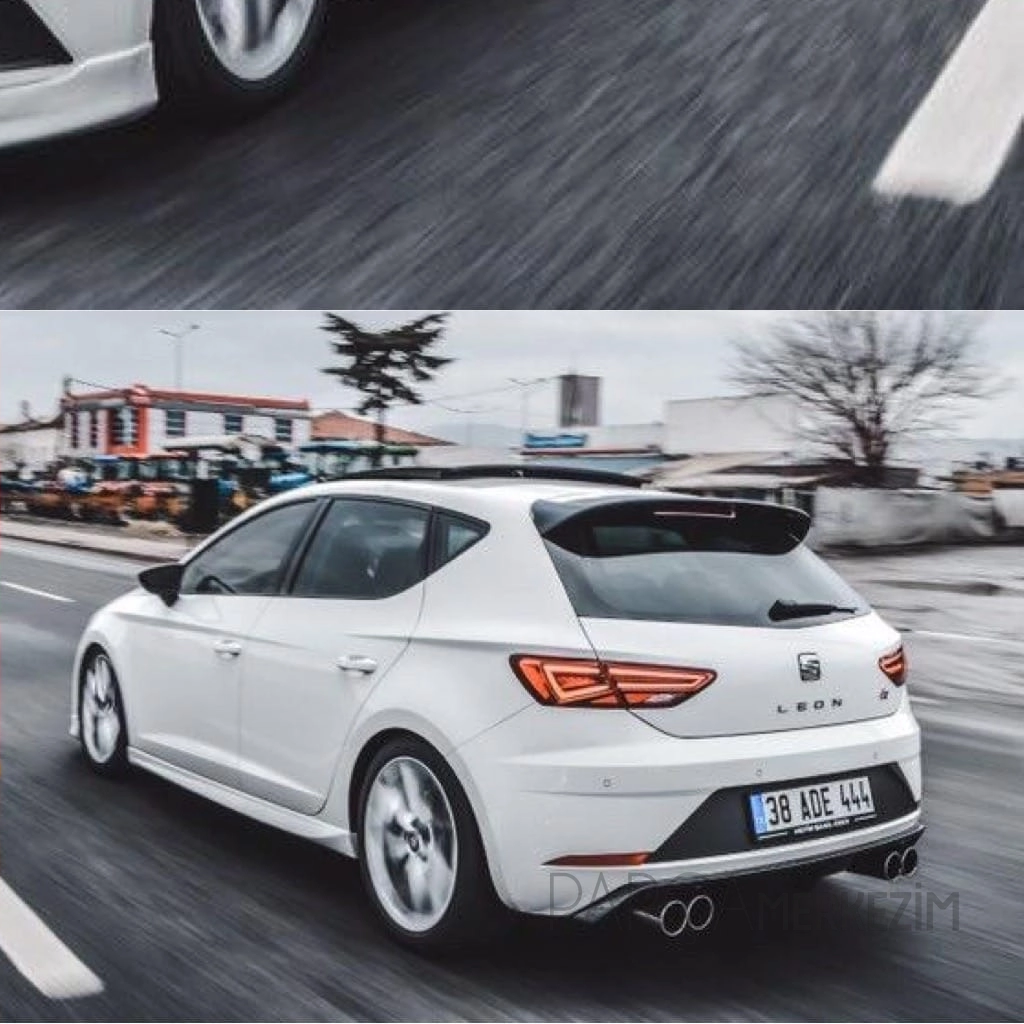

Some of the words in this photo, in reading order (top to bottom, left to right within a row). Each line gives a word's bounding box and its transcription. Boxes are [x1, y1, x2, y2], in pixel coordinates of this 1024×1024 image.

[777, 698, 843, 713] LEON
[766, 795, 792, 825] 38
[800, 787, 833, 821] ADE
[840, 781, 870, 811] 444
